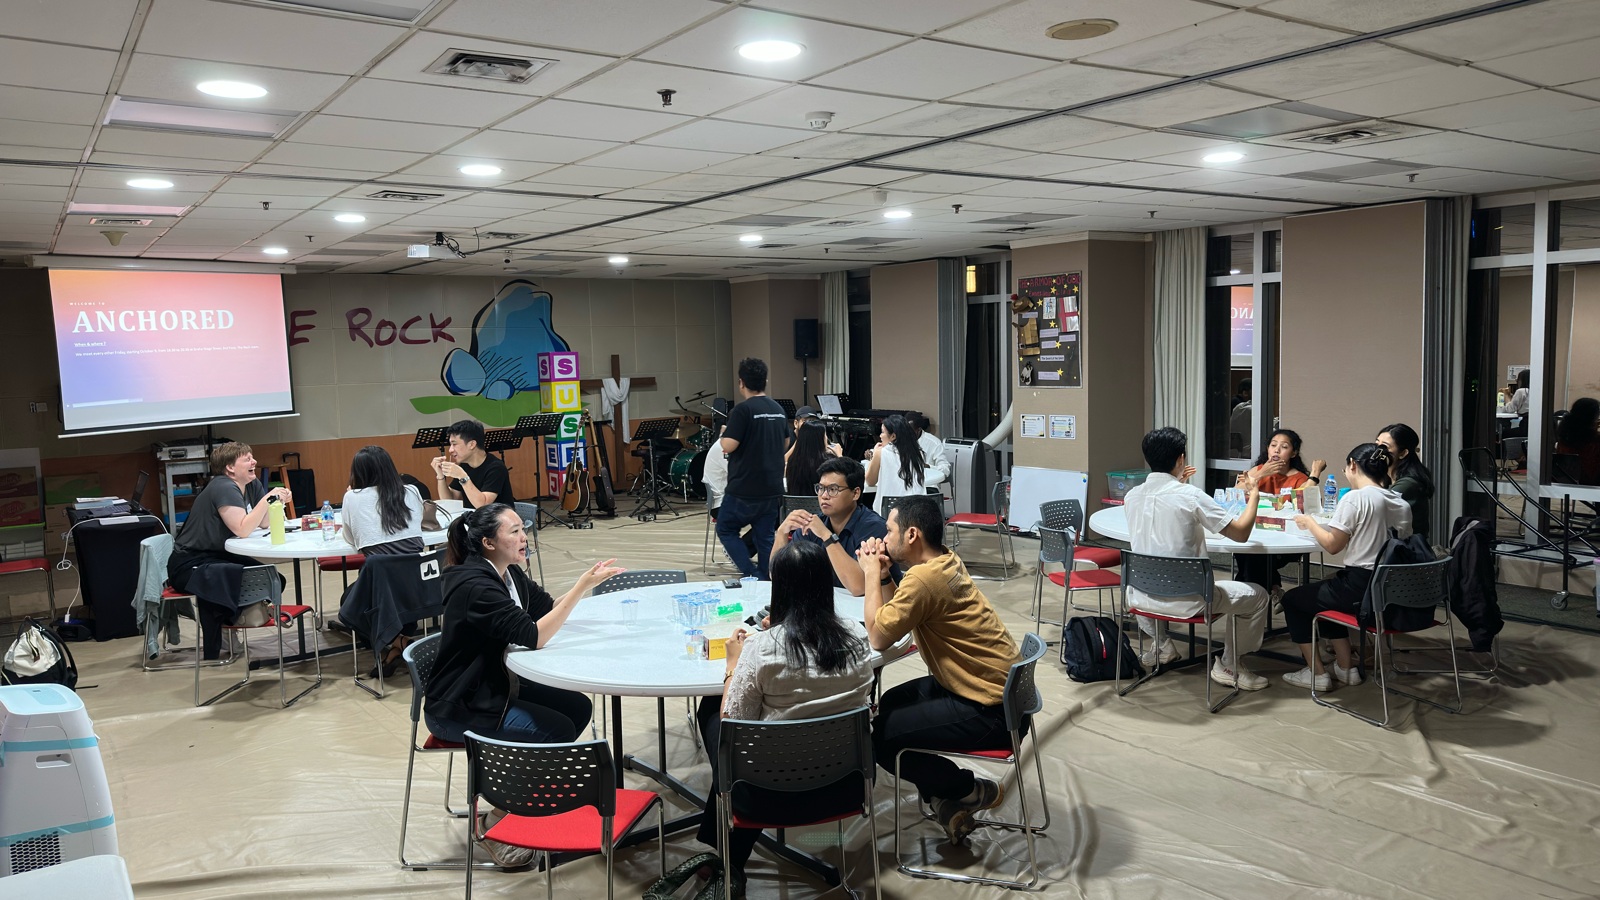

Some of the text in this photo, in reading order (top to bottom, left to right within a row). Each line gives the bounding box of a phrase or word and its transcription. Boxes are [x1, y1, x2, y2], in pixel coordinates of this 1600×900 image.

[1056, 276, 1066, 286] OF
[72, 310, 234, 333] ANCHORED
[540, 359, 548, 376] S
[557, 358, 573, 375] S
[542, 389, 549, 406] U
[558, 388, 574, 405] U
[563, 417, 578, 434] S
[548, 448, 556, 463] E
[551, 477, 556, 492] J
